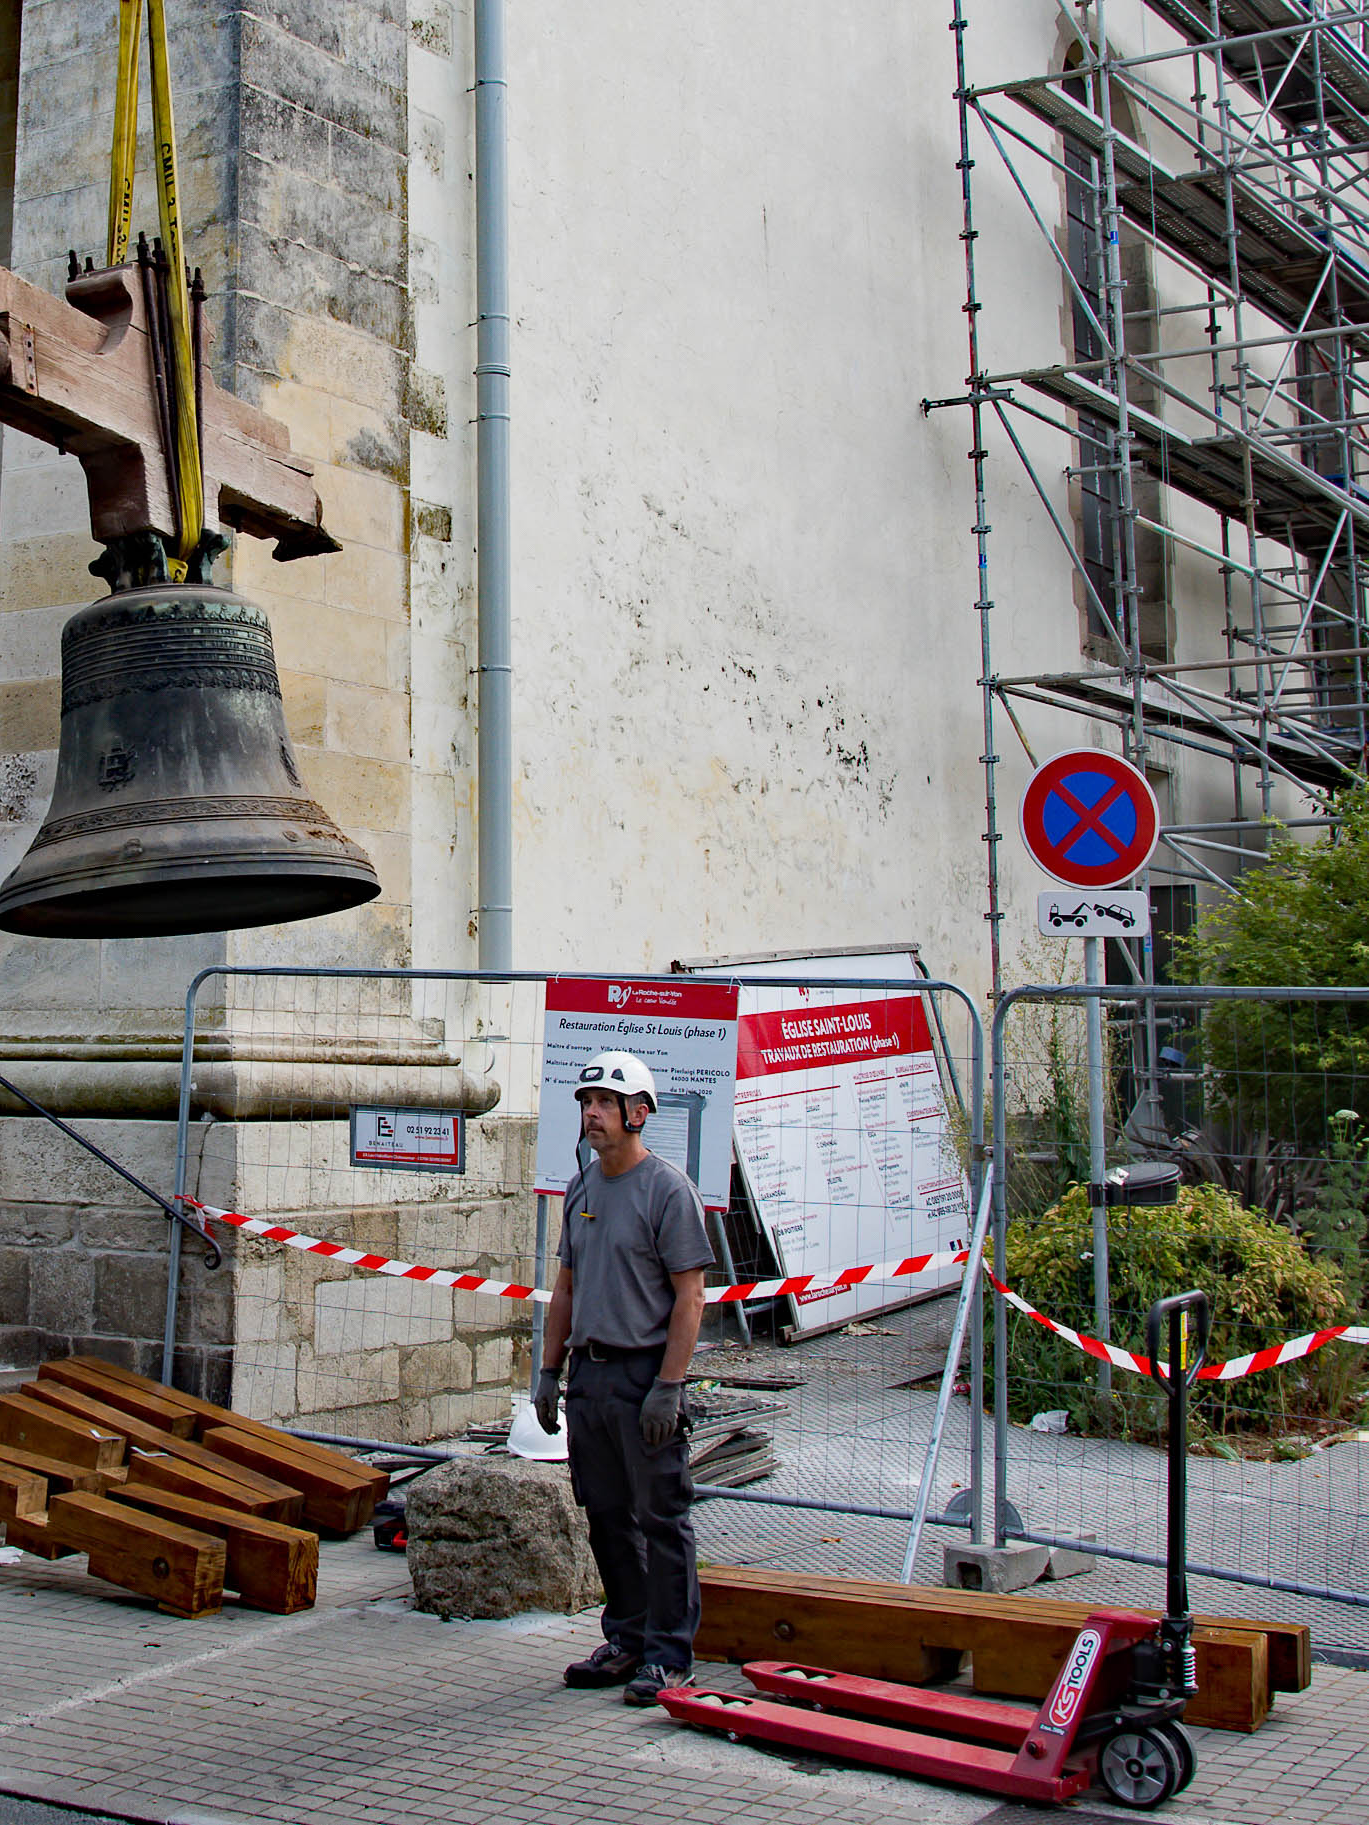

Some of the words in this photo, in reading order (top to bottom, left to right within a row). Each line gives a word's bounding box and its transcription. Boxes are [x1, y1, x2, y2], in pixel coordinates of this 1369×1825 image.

[559, 1018, 616, 1032] Restauration
[617, 1018, 644, 1036] Église
[645, 1023, 656, 1034] St
[657, 1025, 681, 1036] Louis
[684, 1027, 715, 1040] (phase
[717, 1027, 727, 1041] 1)
[781, 1017, 815, 1040] ÉGLISE
[815, 1012, 871, 1036] SAINT-LOUIS
[629, 1047, 645, 1055] Roche
[761, 1046, 800, 1064] TRAVAUX
[801, 1045, 813, 1058] DE
[812, 1036, 870, 1057] RESTAURATION
[870, 1035, 892, 1053] (phase
[892, 1032, 900, 1049] 1)
[671, 1067, 695, 1076] Pierluigi
[696, 1068, 731, 1077] PERICOLO
[406, 1125, 415, 1134] 02
[415, 1126, 423, 1134] 51
[424, 1126, 433, 1135] 92
[433, 1127, 441, 1136] 23
[441, 1128, 449, 1136] 41
[1067, 1637, 1094, 1687] TOOLS
